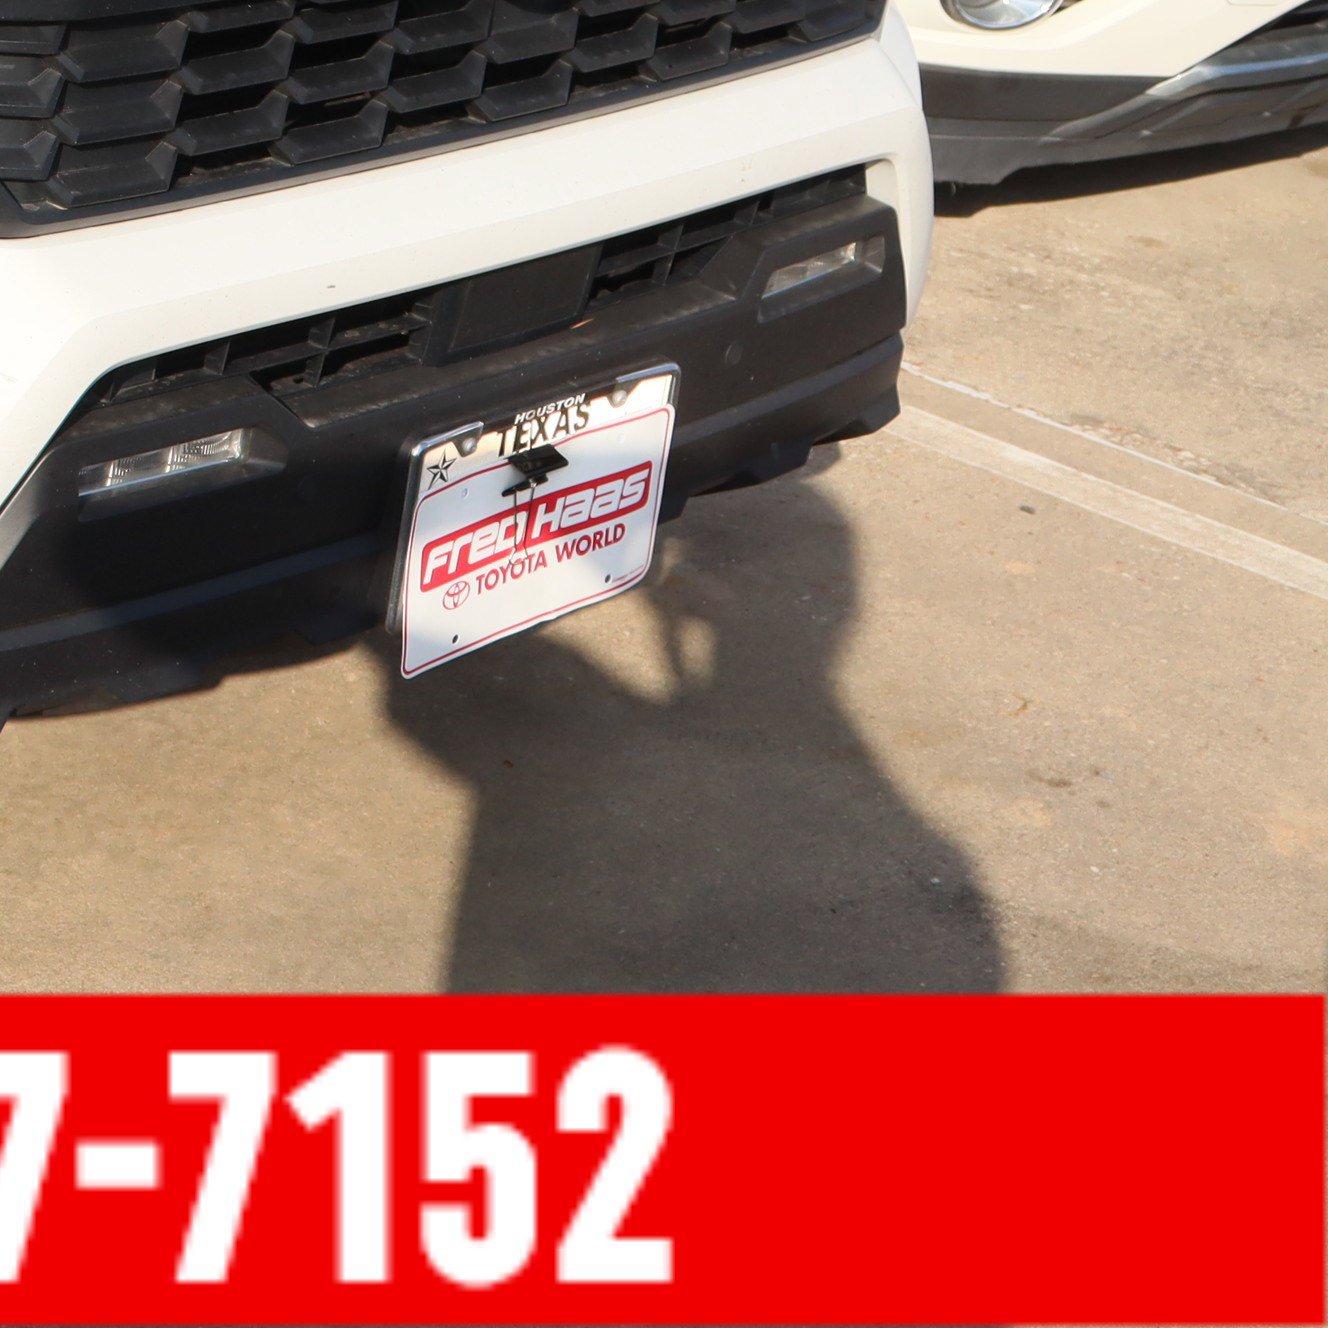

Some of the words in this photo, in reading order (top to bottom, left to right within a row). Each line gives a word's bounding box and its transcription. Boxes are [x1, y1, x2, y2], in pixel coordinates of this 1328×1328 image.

[497, 401, 593, 457] TEXAS
[514, 392, 586, 424] HOUSTON
[476, 554, 548, 595] TOYOTA
[554, 522, 626, 563] WORLD
